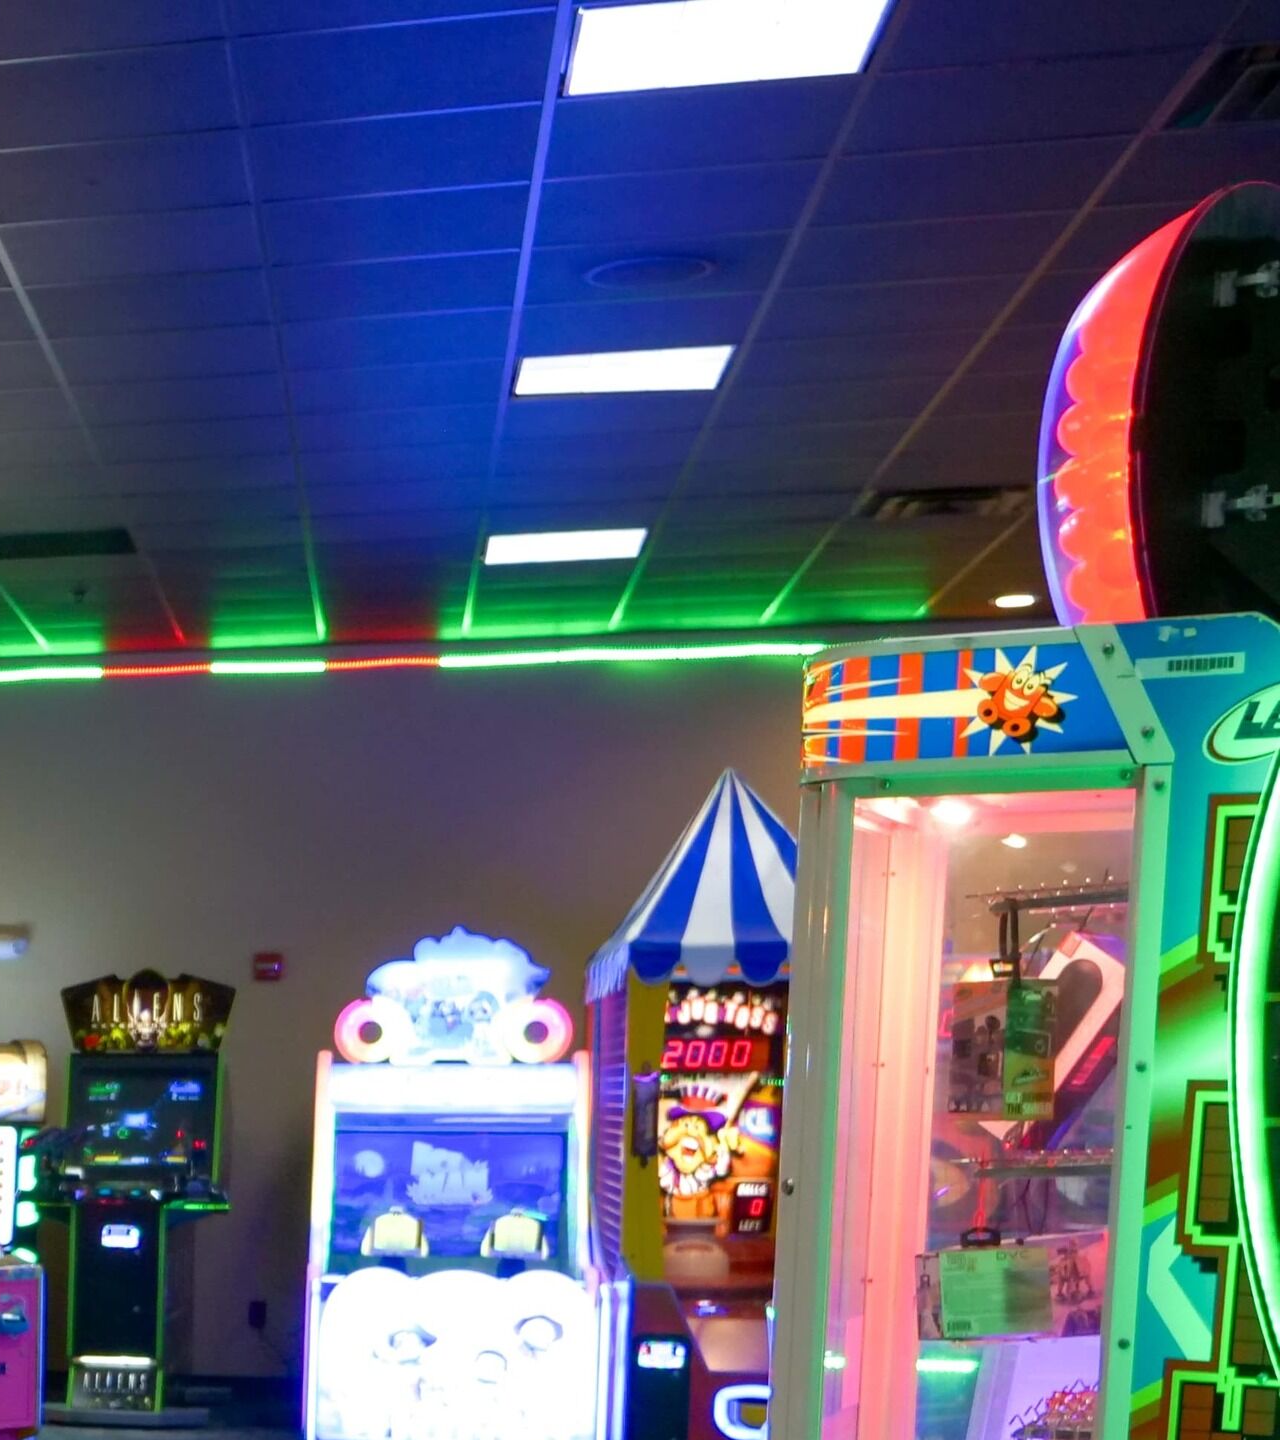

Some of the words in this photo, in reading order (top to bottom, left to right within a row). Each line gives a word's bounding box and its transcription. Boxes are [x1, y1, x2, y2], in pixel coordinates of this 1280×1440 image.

[92, 990, 202, 1022] ALIENS
[724, 1000, 779, 1035] TOSS
[661, 1040, 753, 1069] 2000
[750, 1199, 764, 1217] 0
